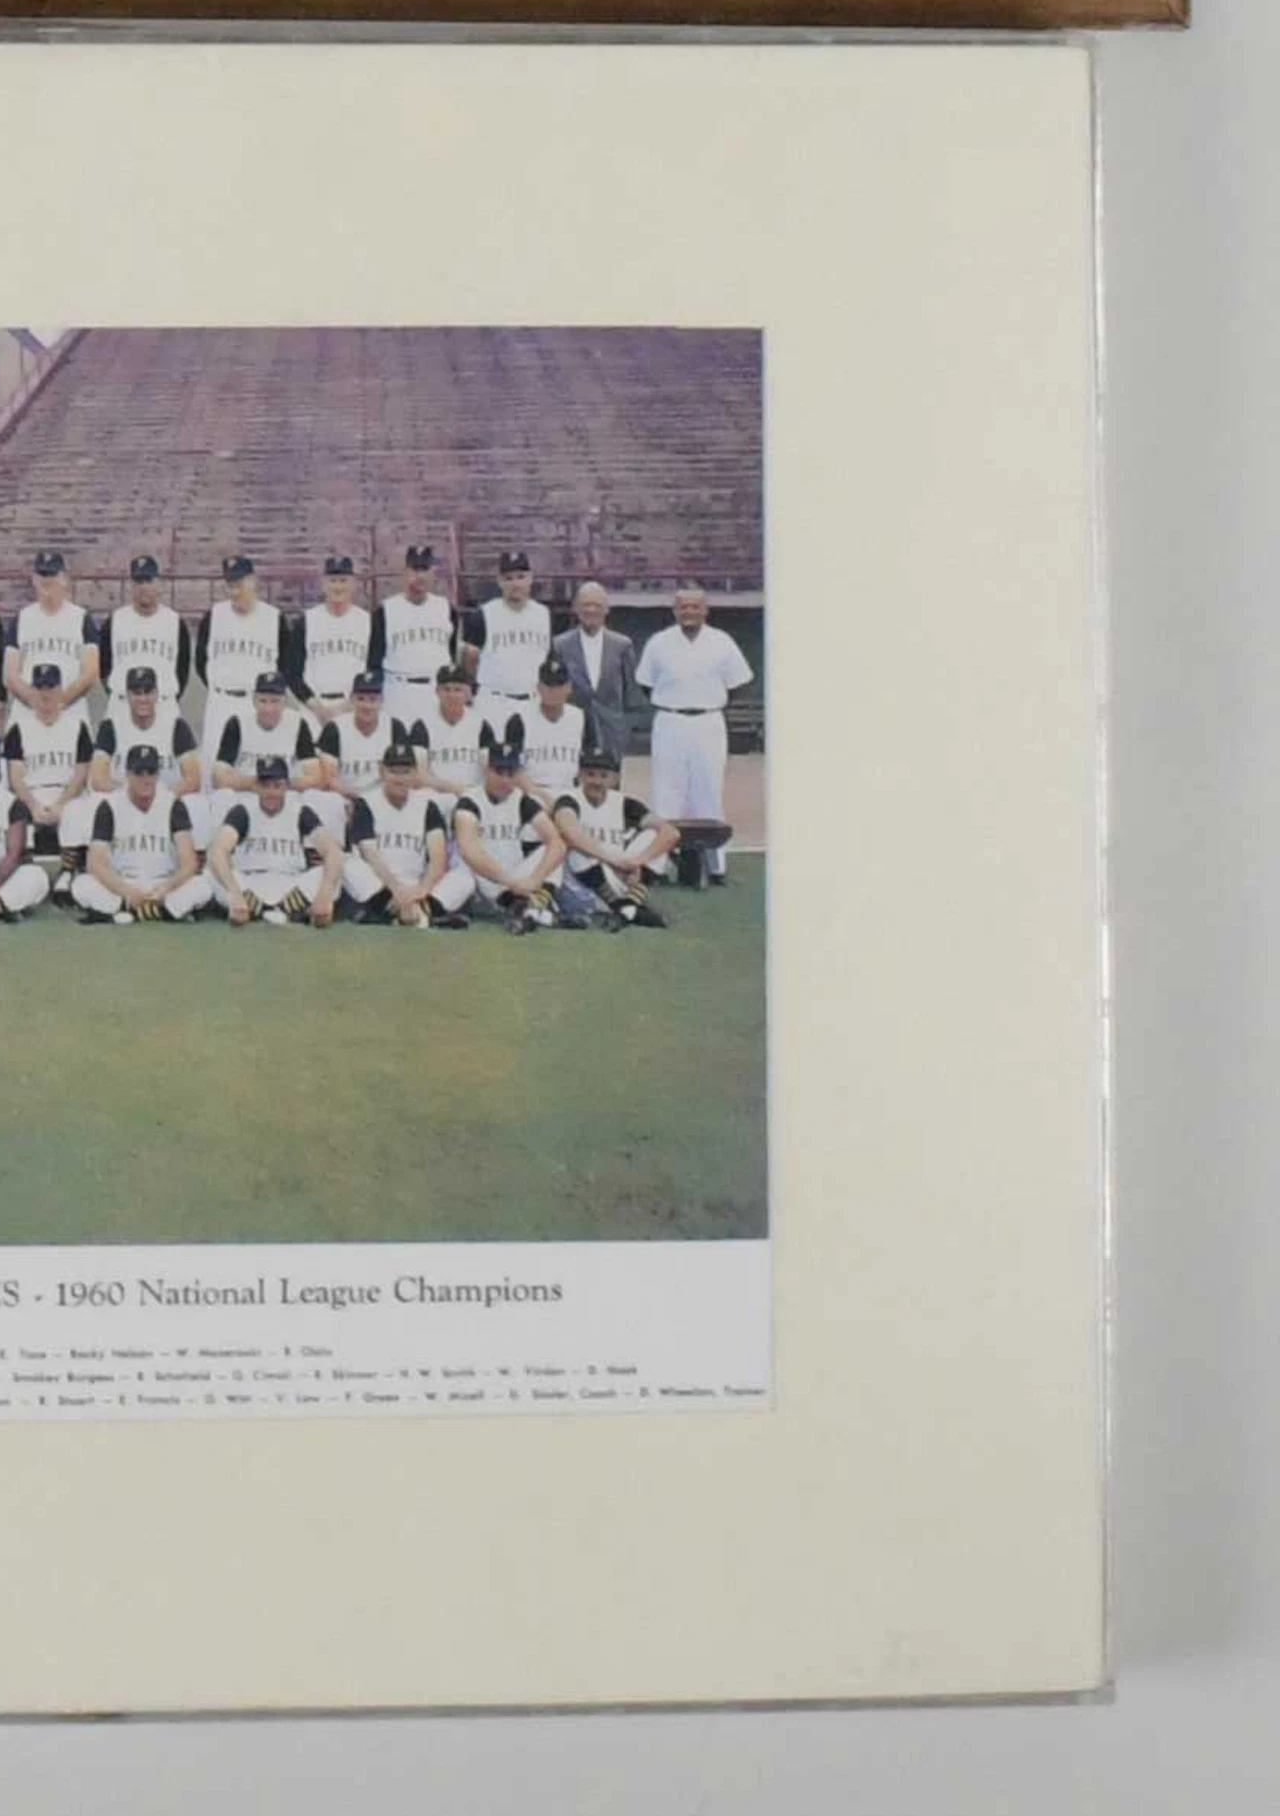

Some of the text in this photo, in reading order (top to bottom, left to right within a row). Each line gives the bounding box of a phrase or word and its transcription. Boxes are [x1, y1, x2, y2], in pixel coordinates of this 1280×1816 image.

[56, 1280, 126, 1308] 1960
[137, 1277, 266, 1306] National
[279, 1276, 382, 1310] League
[392, 1274, 564, 1310] Champions
